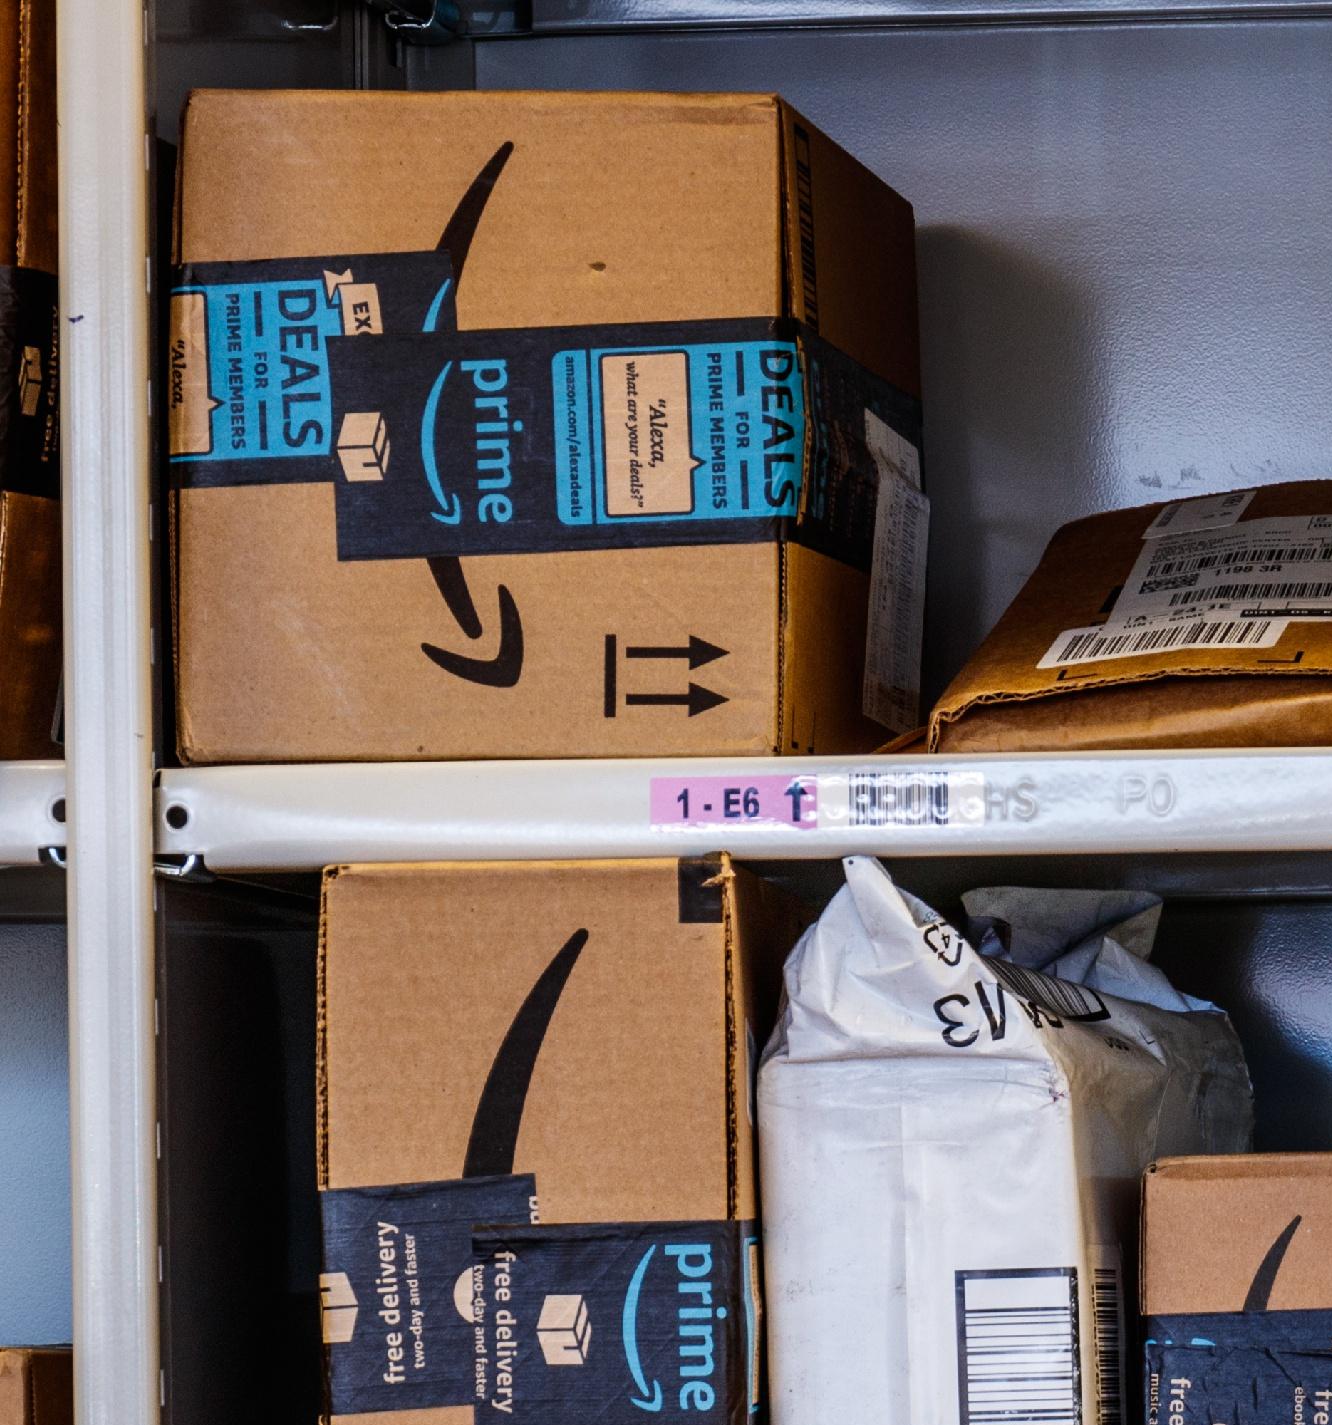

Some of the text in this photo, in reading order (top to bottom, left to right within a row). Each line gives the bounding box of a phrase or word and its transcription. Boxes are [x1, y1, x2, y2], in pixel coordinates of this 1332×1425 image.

[225, 294, 246, 450] PRIME MEMBERS
[254, 352, 268, 389] FOR
[278, 289, 323, 448] DEALS
[461, 359, 523, 524] prime
[564, 356, 580, 518] amazon.com/alexadeals
[626, 361, 636, 396] what
[626, 421, 638, 454] your
[627, 399, 636, 419] are
[706, 352, 727, 509] PRIME MEMBERS
[737, 412, 748, 448] FOR
[759, 349, 795, 508] DEALS
[676, 787, 760, 818] 1 E6
[376, 1221, 406, 1384] free delivery
[405, 1233, 424, 1369] two-day and faster
[473, 1264, 486, 1400] two-day and faster
[492, 1250, 517, 1414] free delivery
[664, 1243, 727, 1412] prime
[1150, 1373, 1159, 1417] music
